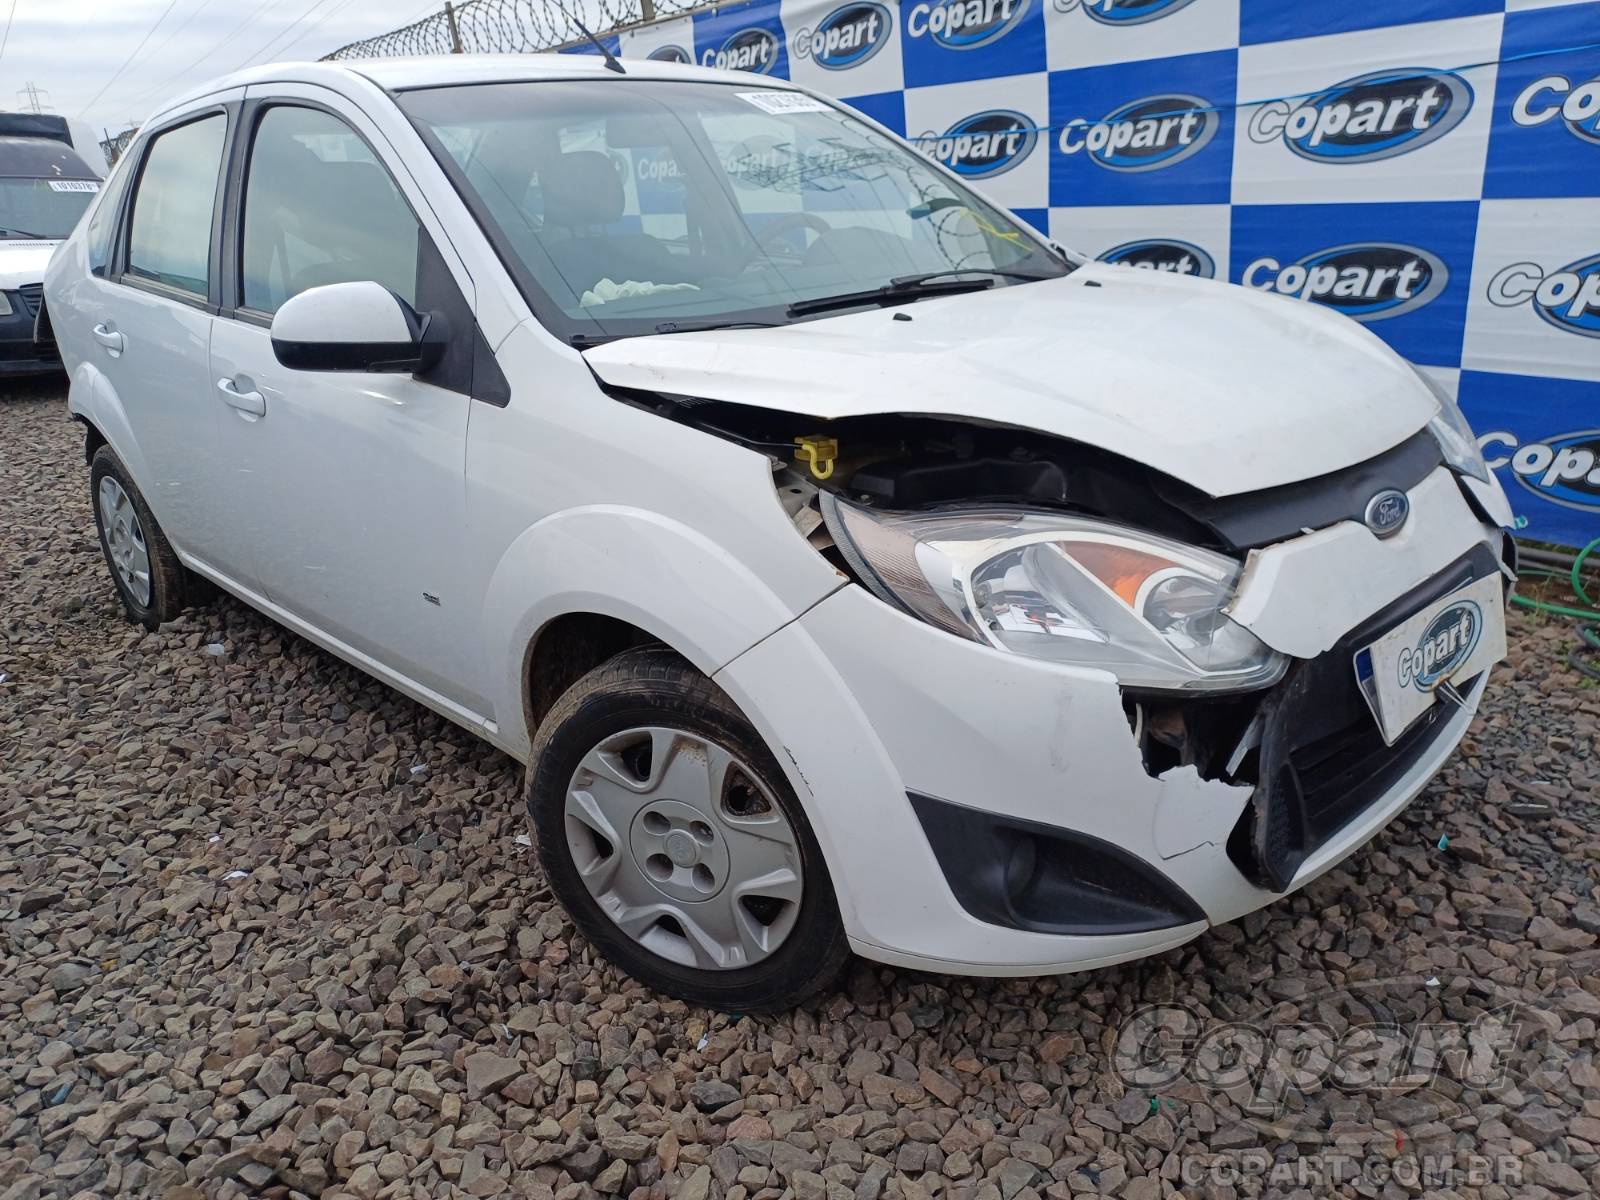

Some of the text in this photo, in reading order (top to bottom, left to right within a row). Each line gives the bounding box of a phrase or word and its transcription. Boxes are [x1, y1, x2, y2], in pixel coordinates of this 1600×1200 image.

[792, 11, 880, 60] Copart
[908, 0, 1011, 38] Copart
[702, 36, 770, 70] Copart
[1059, 108, 1197, 157] Copart
[1248, 85, 1441, 147] Copart
[637, 157, 680, 182] Copa
[1241, 256, 1422, 302] Copart
[1477, 430, 1600, 489] Cop
[1379, 498, 1400, 525] Ford
[1398, 609, 1471, 688] Copart
